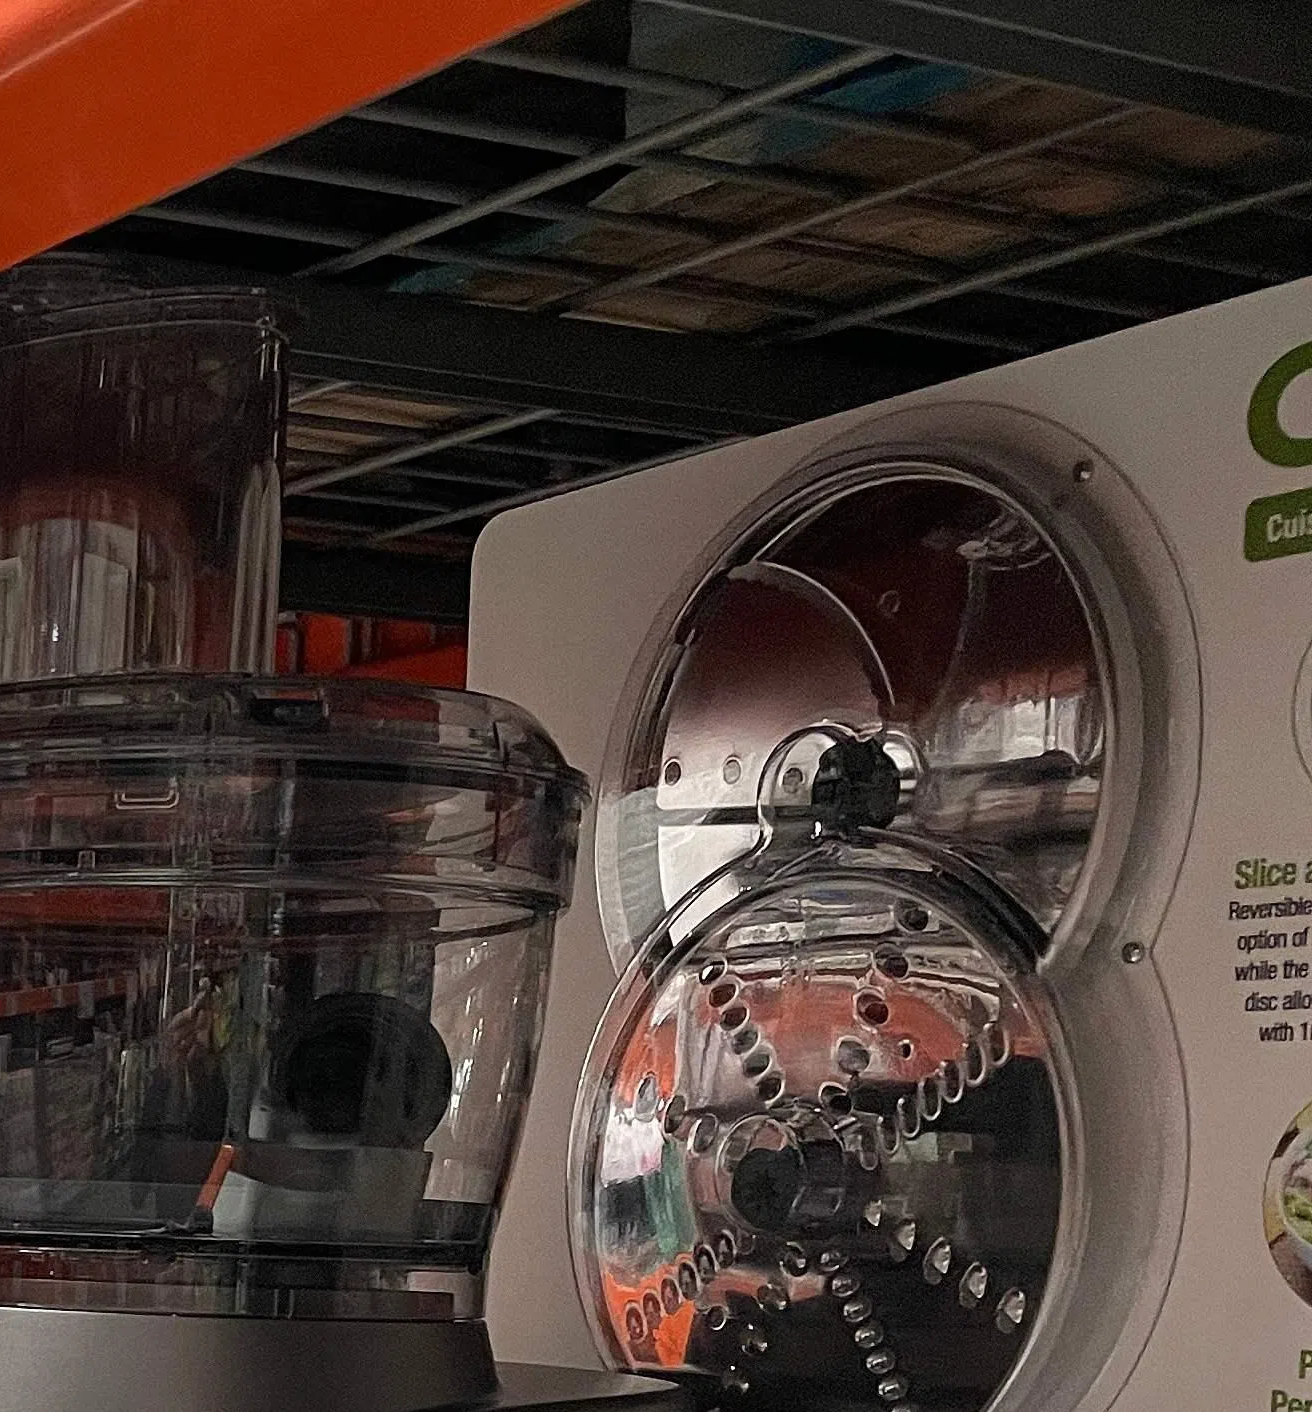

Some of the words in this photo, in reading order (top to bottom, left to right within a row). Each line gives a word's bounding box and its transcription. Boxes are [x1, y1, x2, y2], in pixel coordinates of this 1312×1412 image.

[1235, 858, 1296, 890] Slice
[1229, 897, 1312, 921] Reversible
[1237, 930, 1287, 954] option
[1292, 927, 1310, 947] of
[1235, 961, 1277, 981] while
[1283, 960, 1309, 979] the
[1245, 992, 1278, 1012] disc
[1259, 1022, 1294, 1042] with
